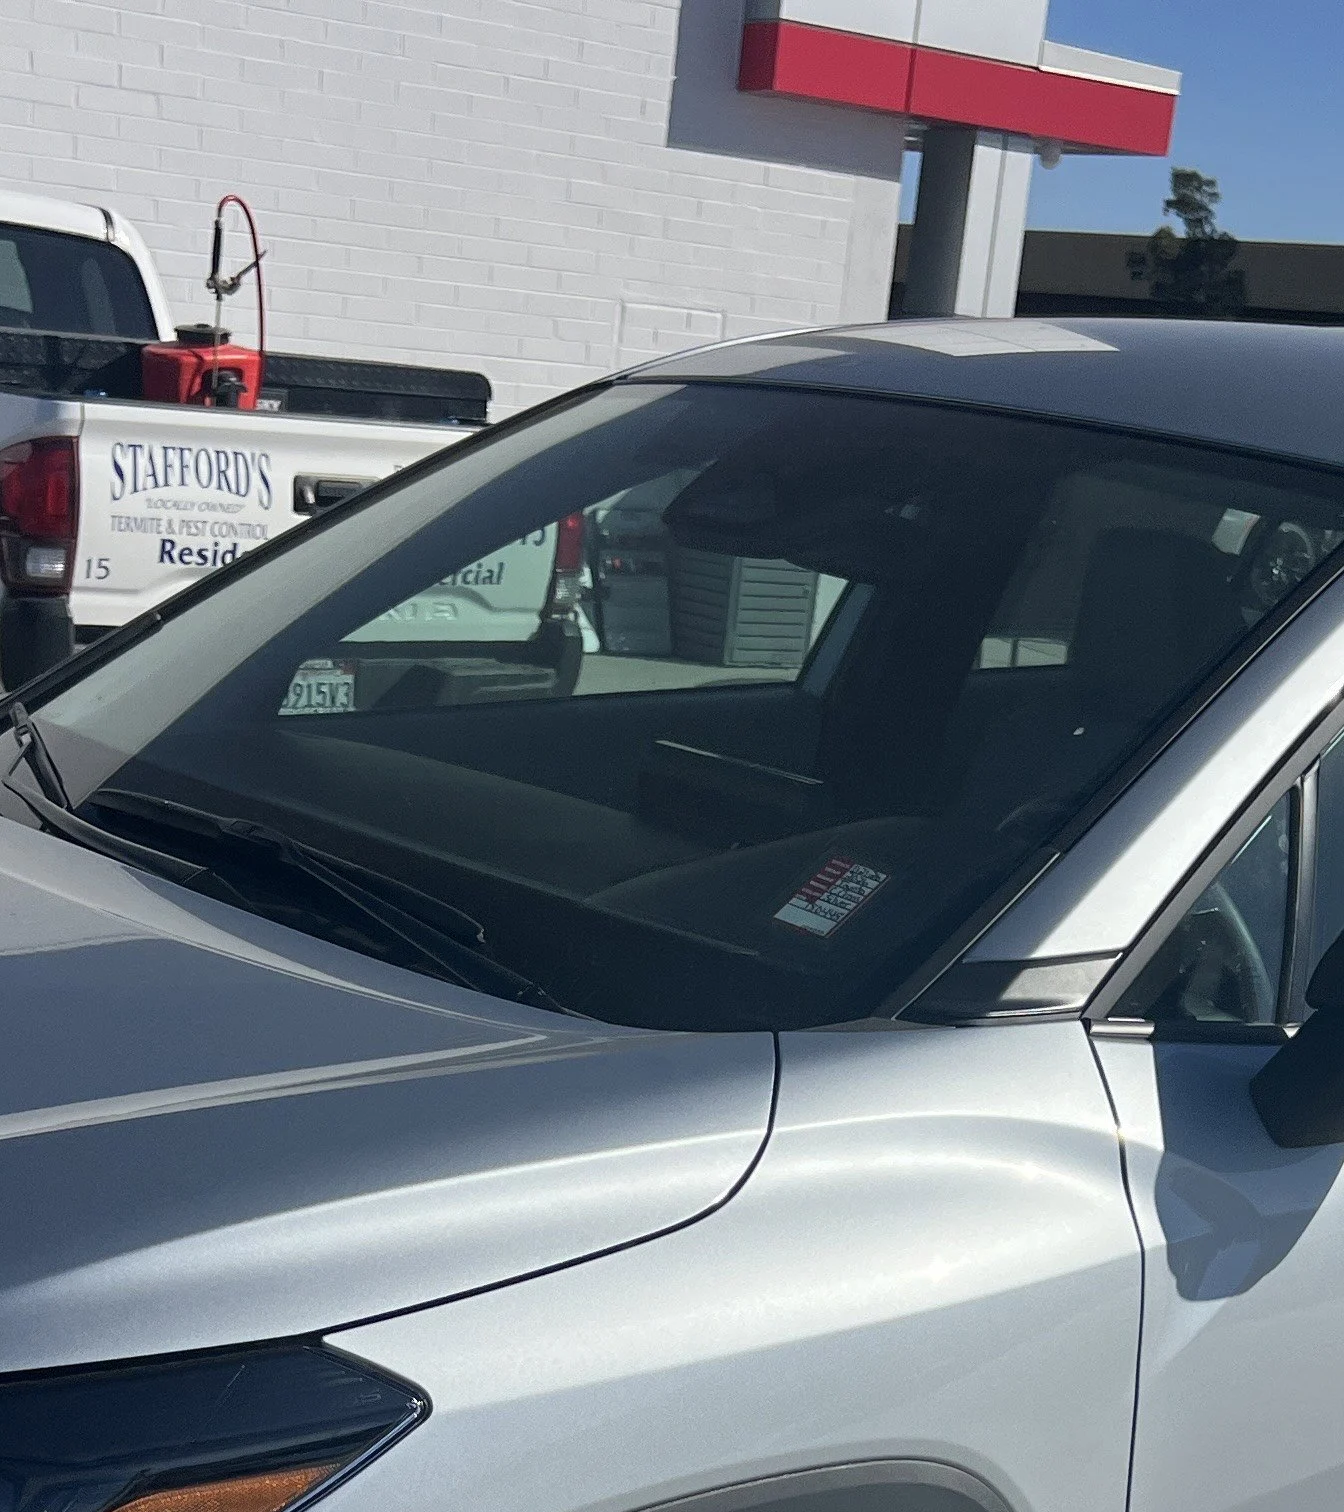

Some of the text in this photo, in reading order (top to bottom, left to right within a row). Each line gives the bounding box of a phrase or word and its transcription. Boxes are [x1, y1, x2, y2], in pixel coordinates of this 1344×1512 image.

[110, 442, 273, 511] STAFFORD'S
[110, 515, 269, 541] TERMITE & PEST CONTROL
[158, 538, 247, 567] Resid
[85, 557, 111, 580] 15
[438, 561, 505, 586] rcial
